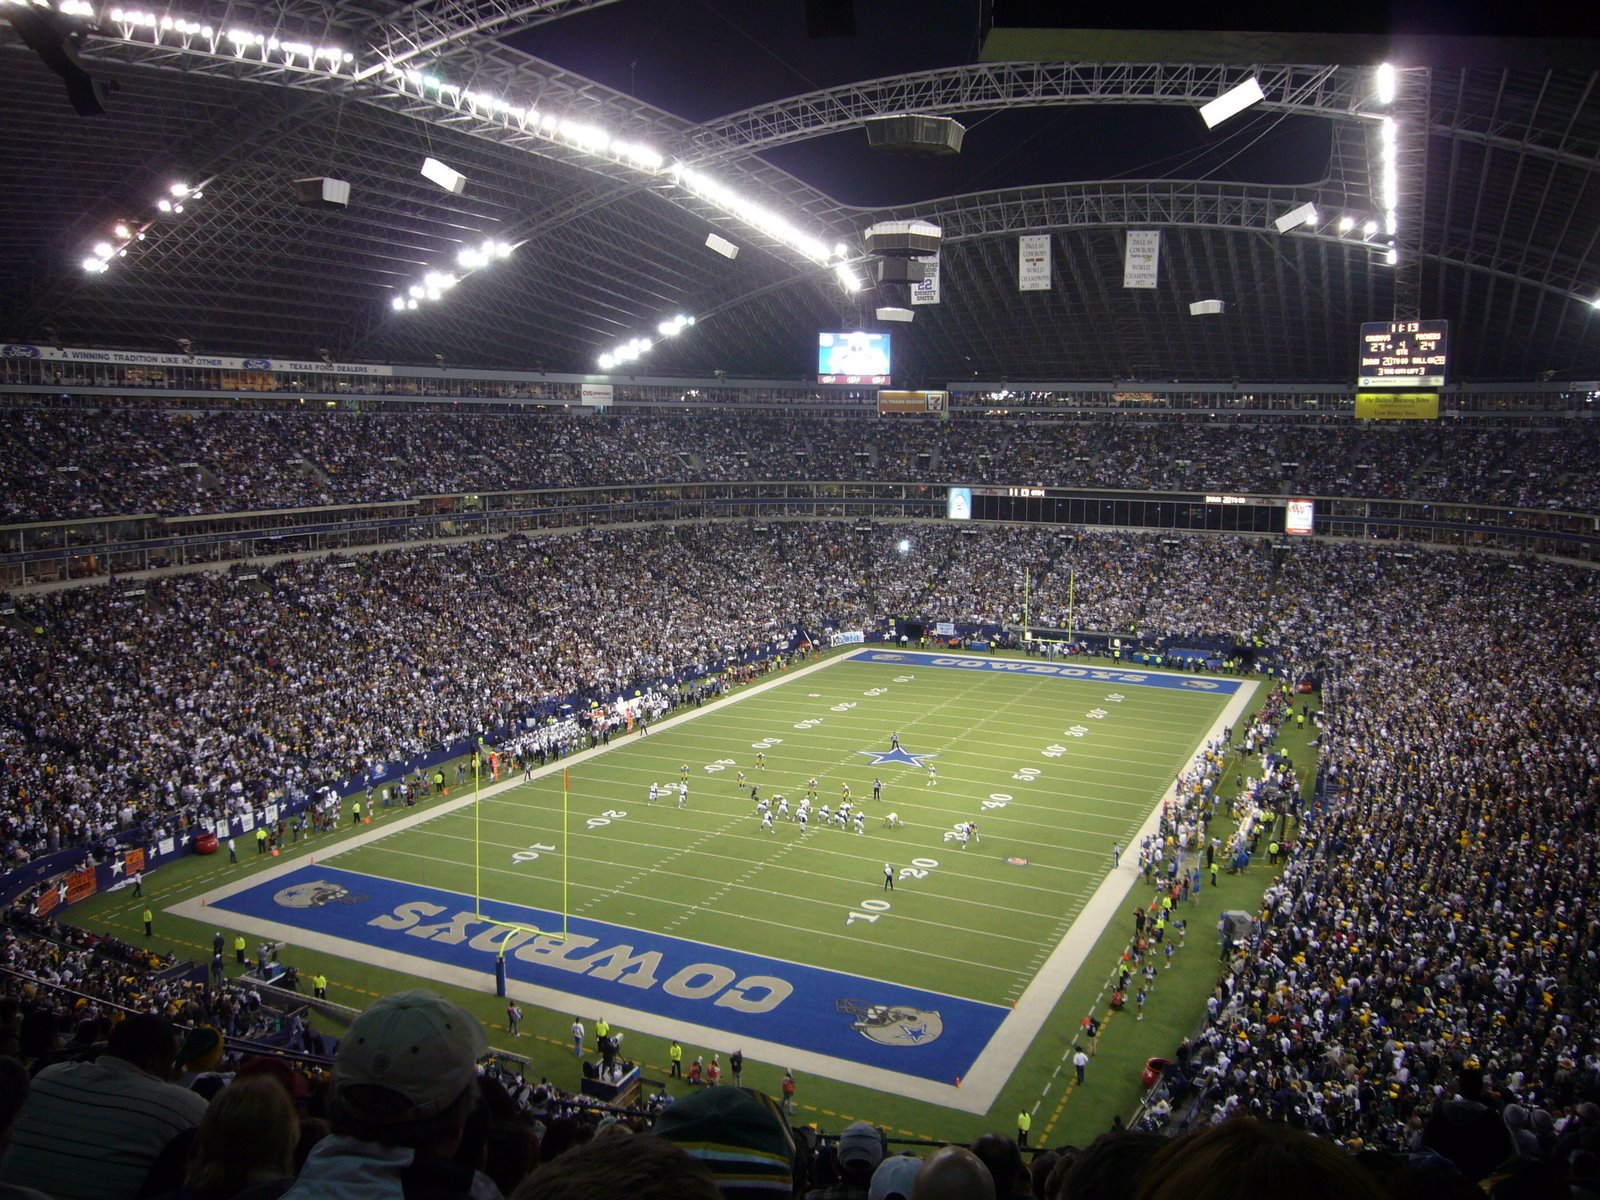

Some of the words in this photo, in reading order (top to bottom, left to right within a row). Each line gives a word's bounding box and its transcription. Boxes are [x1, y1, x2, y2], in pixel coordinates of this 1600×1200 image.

[918, 279, 932, 290] 22
[1391, 323, 1419, 333] 11:13
[1370, 343, 1385, 352] 27
[1400, 341, 1406, 349] 4
[1420, 341, 1435, 350] 24
[72, 352, 110, 360] WINNING
[113, 354, 158, 362] TRADITION
[932, 658, 1148, 682] COWBOYS
[1104, 694, 1125, 702] 10
[1064, 726, 1088, 737] 30
[752, 738, 784, 749] 50
[1041, 746, 1067, 757] 40
[704, 759, 736, 771] 40
[1012, 767, 1042, 781] 50
[982, 794, 1013, 808] 40
[586, 810, 628, 826] 20
[512, 842, 556, 861] 10
[900, 858, 939, 879] 20
[848, 900, 892, 923] 10
[367, 902, 795, 1014] COWBOYS
